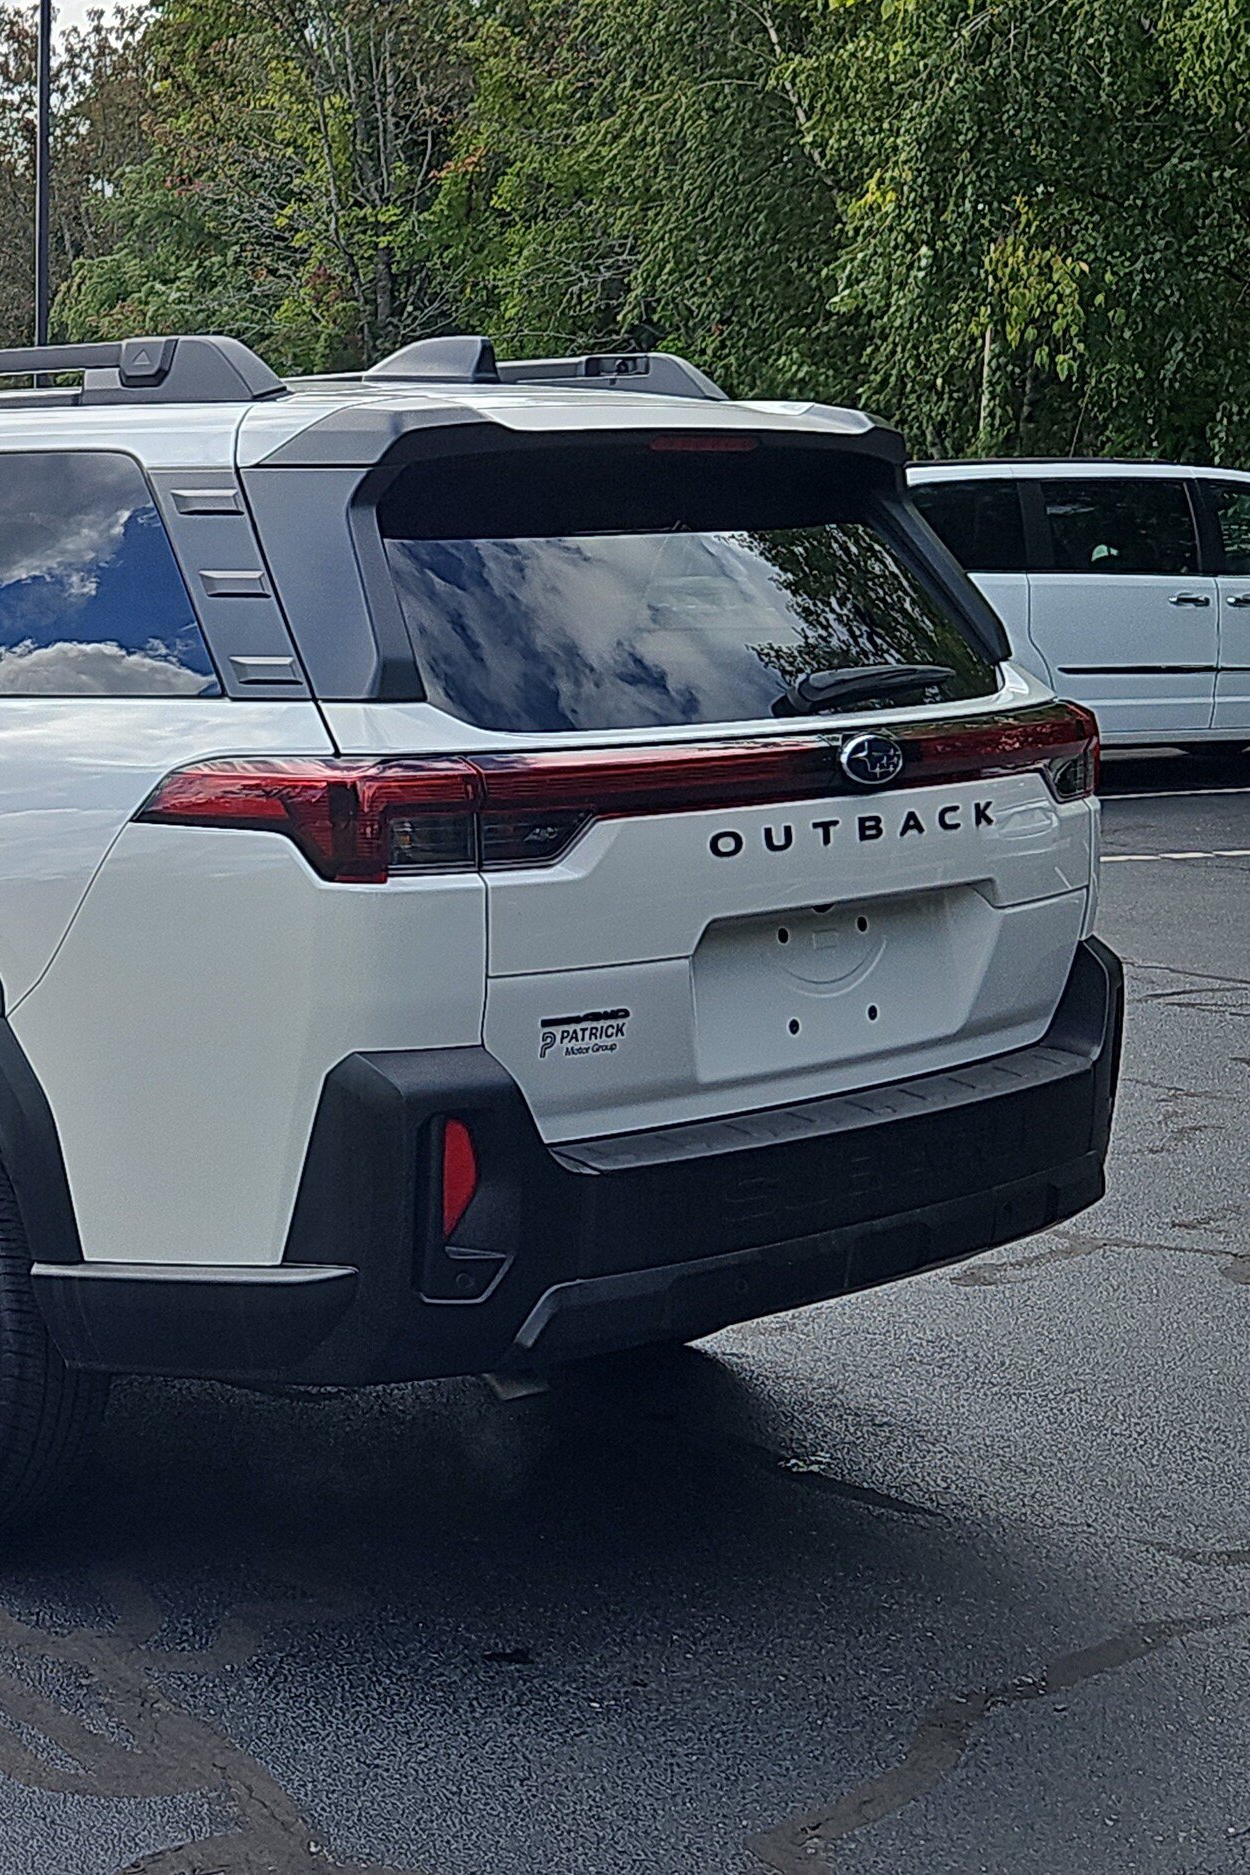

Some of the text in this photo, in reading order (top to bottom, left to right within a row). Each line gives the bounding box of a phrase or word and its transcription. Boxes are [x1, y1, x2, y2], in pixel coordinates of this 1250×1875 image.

[708, 800, 995, 859] OUTBACK
[559, 1022, 626, 1044] PATRICK
[565, 1043, 617, 1056] Motor Group
